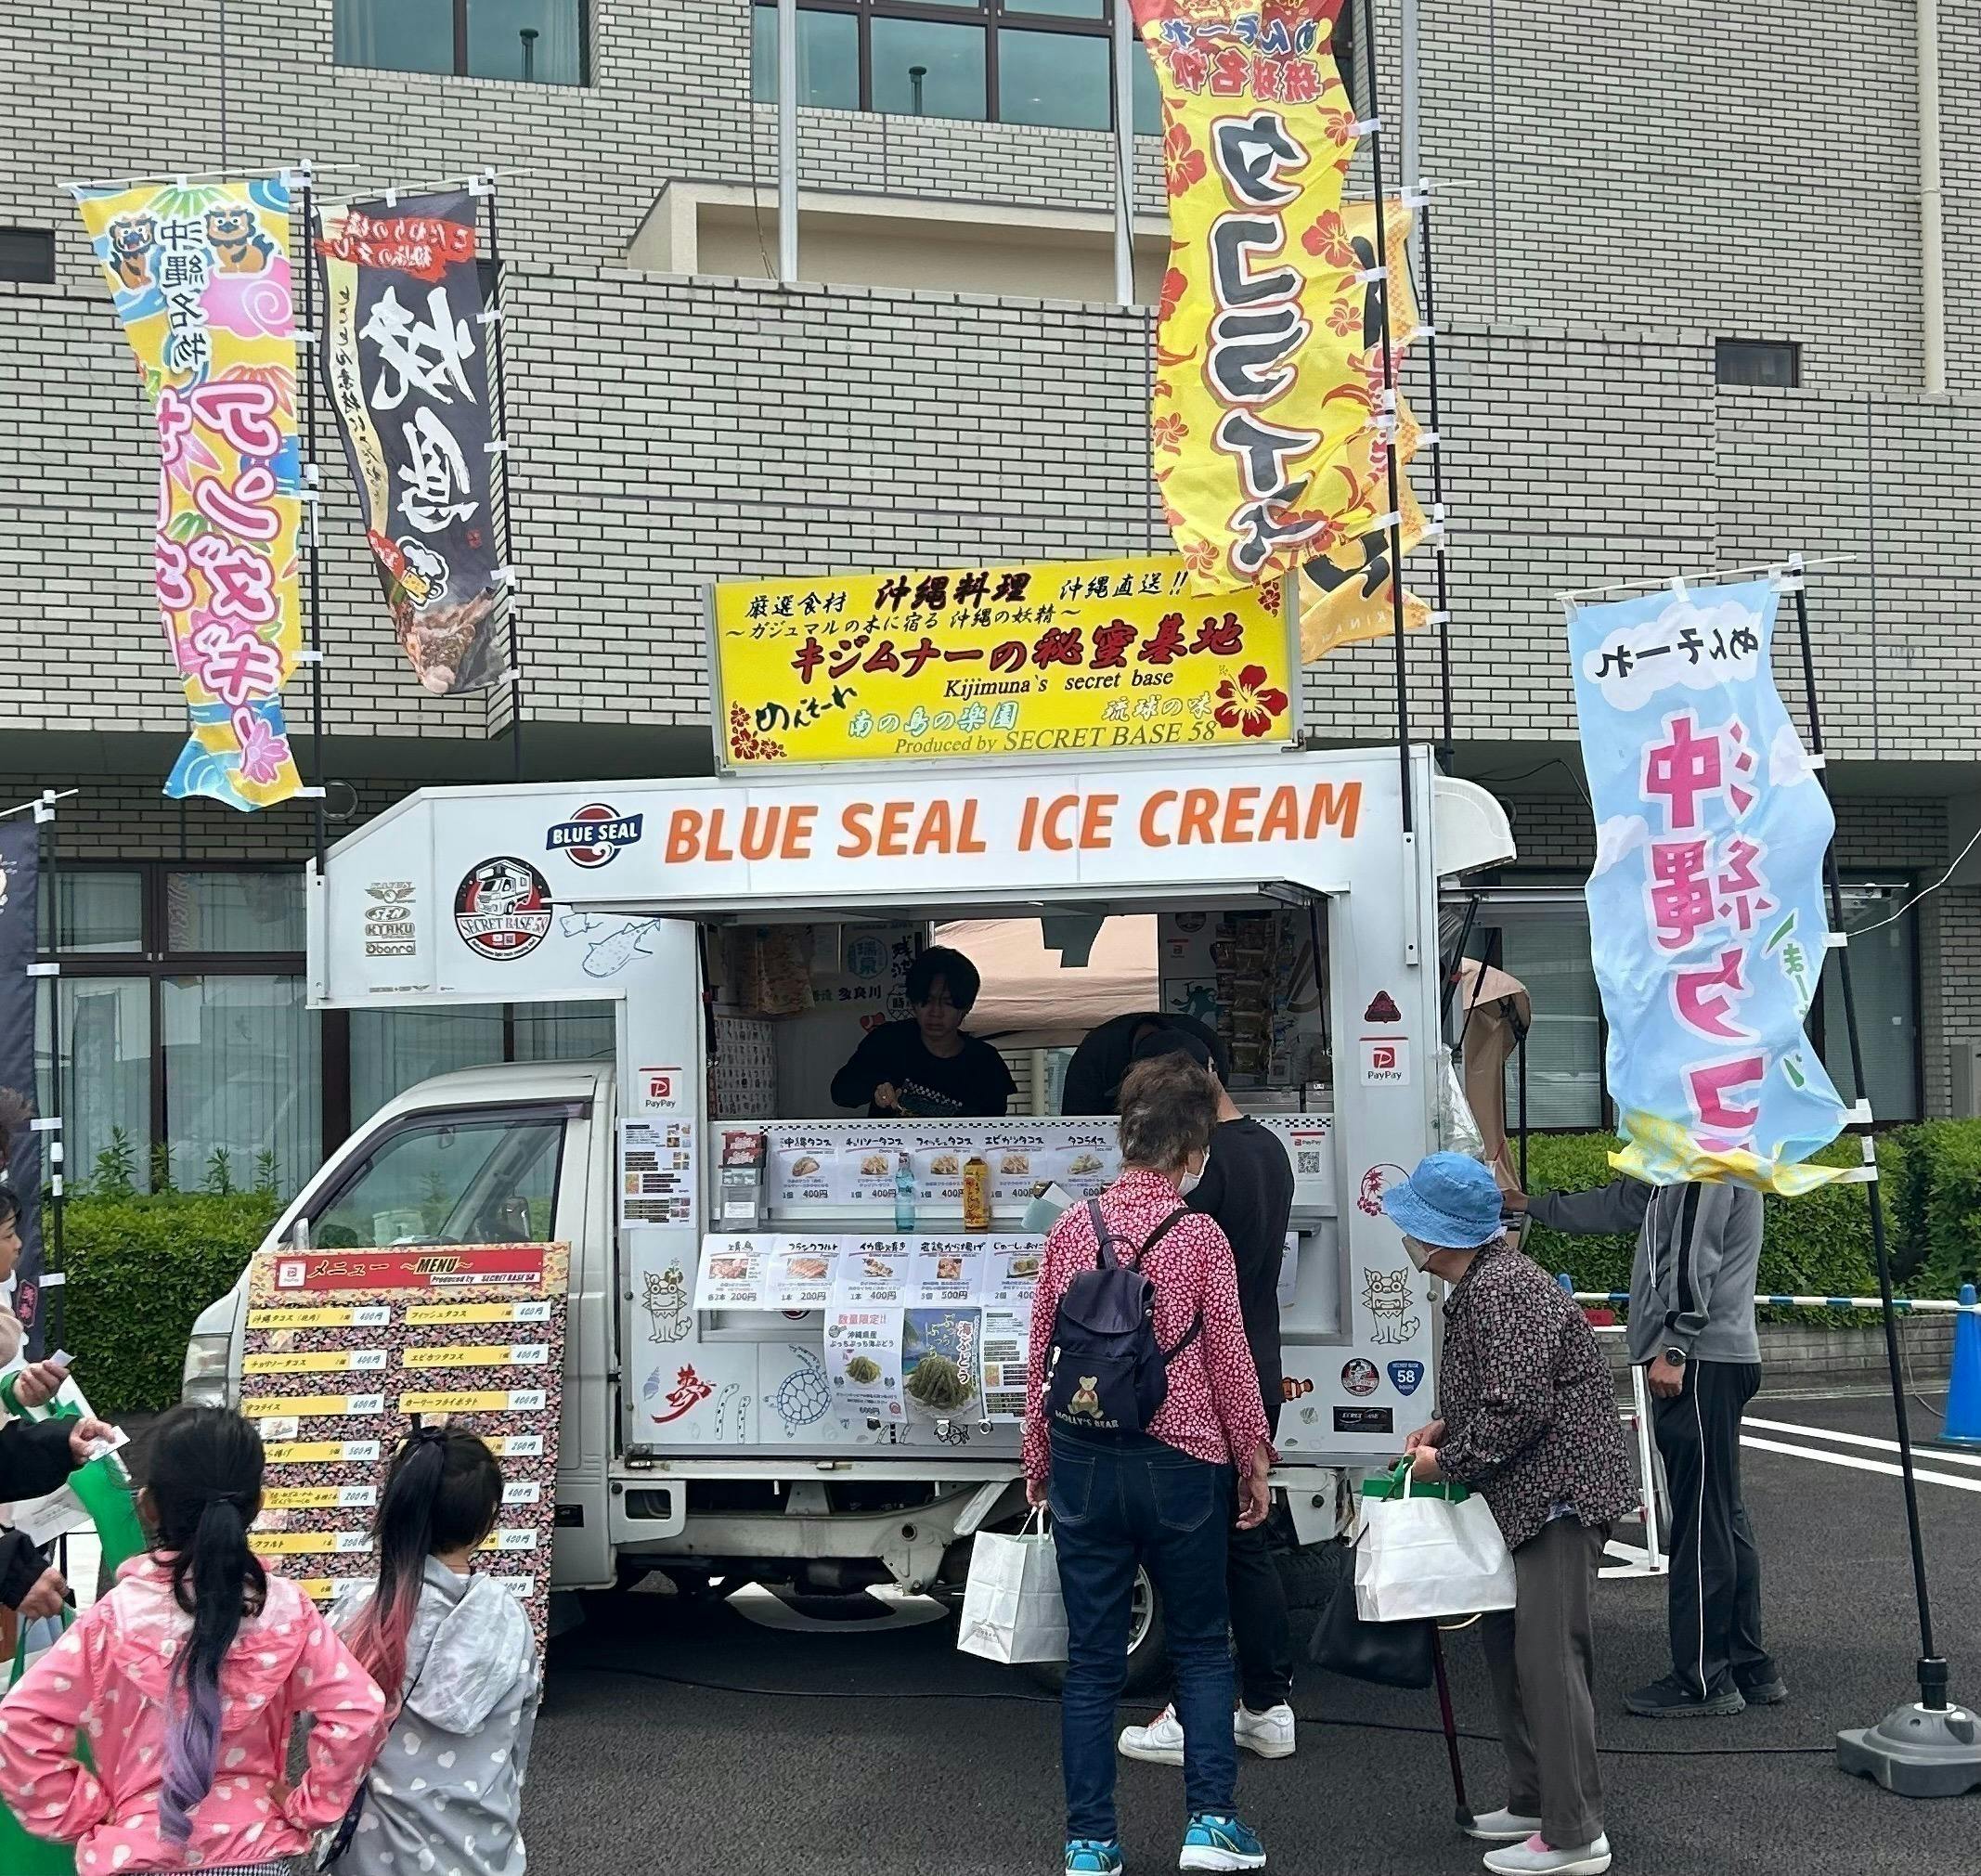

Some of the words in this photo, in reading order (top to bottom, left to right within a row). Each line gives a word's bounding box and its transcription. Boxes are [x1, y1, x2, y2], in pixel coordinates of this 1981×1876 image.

[874, 571, 1032, 613] 沖縄料理
[744, 590, 847, 618] 厳選食材
[1064, 672, 1121, 691] secret
[1131, 669, 1174, 688] base
[1100, 691, 1214, 721] 琉球の味
[848, 700, 1019, 739] 南の島の楽園
[894, 736, 972, 754] Produced
[977, 734, 997, 753] by
[1003, 726, 1107, 751] SECRET
[1110, 722, 1184, 746] BASE
[1188, 720, 1217, 742] 58
[664, 806, 819, 864] BLUE
[836, 799, 987, 858] SEAL
[1018, 794, 1119, 852] ICE
[1139, 783, 1363, 848] CREAM
[551, 824, 595, 846] BLUE
[598, 822, 639, 841] SEAL
[459, 918, 502, 937] SECRET
[505, 916, 534, 930] BASE
[533, 915, 548, 933] 58
[838, 985, 882, 1002] 多良川
[1366, 1069, 1403, 1081] PayPay
[644, 1099, 677, 1108] PayPay
[1068, 1135, 1106, 1146] タコライス
[1301, 1138, 1322, 1147] PayPay
[802, 1189, 829, 1199] 400円
[871, 1188, 897, 1199] 400円
[1083, 1187, 1101, 1197] 600
[307, 1259, 390, 1279] メニュー
[731, 1292, 757, 1301] 200円
[801, 1291, 827, 1301] 200円
[870, 1291, 898, 1300] 400円
[941, 1290, 968, 1300] 500円
[1017, 1291, 1035, 1300] 400
[1396, 1369, 1416, 1384] 58
[343, 1492, 369, 1501] 200円
